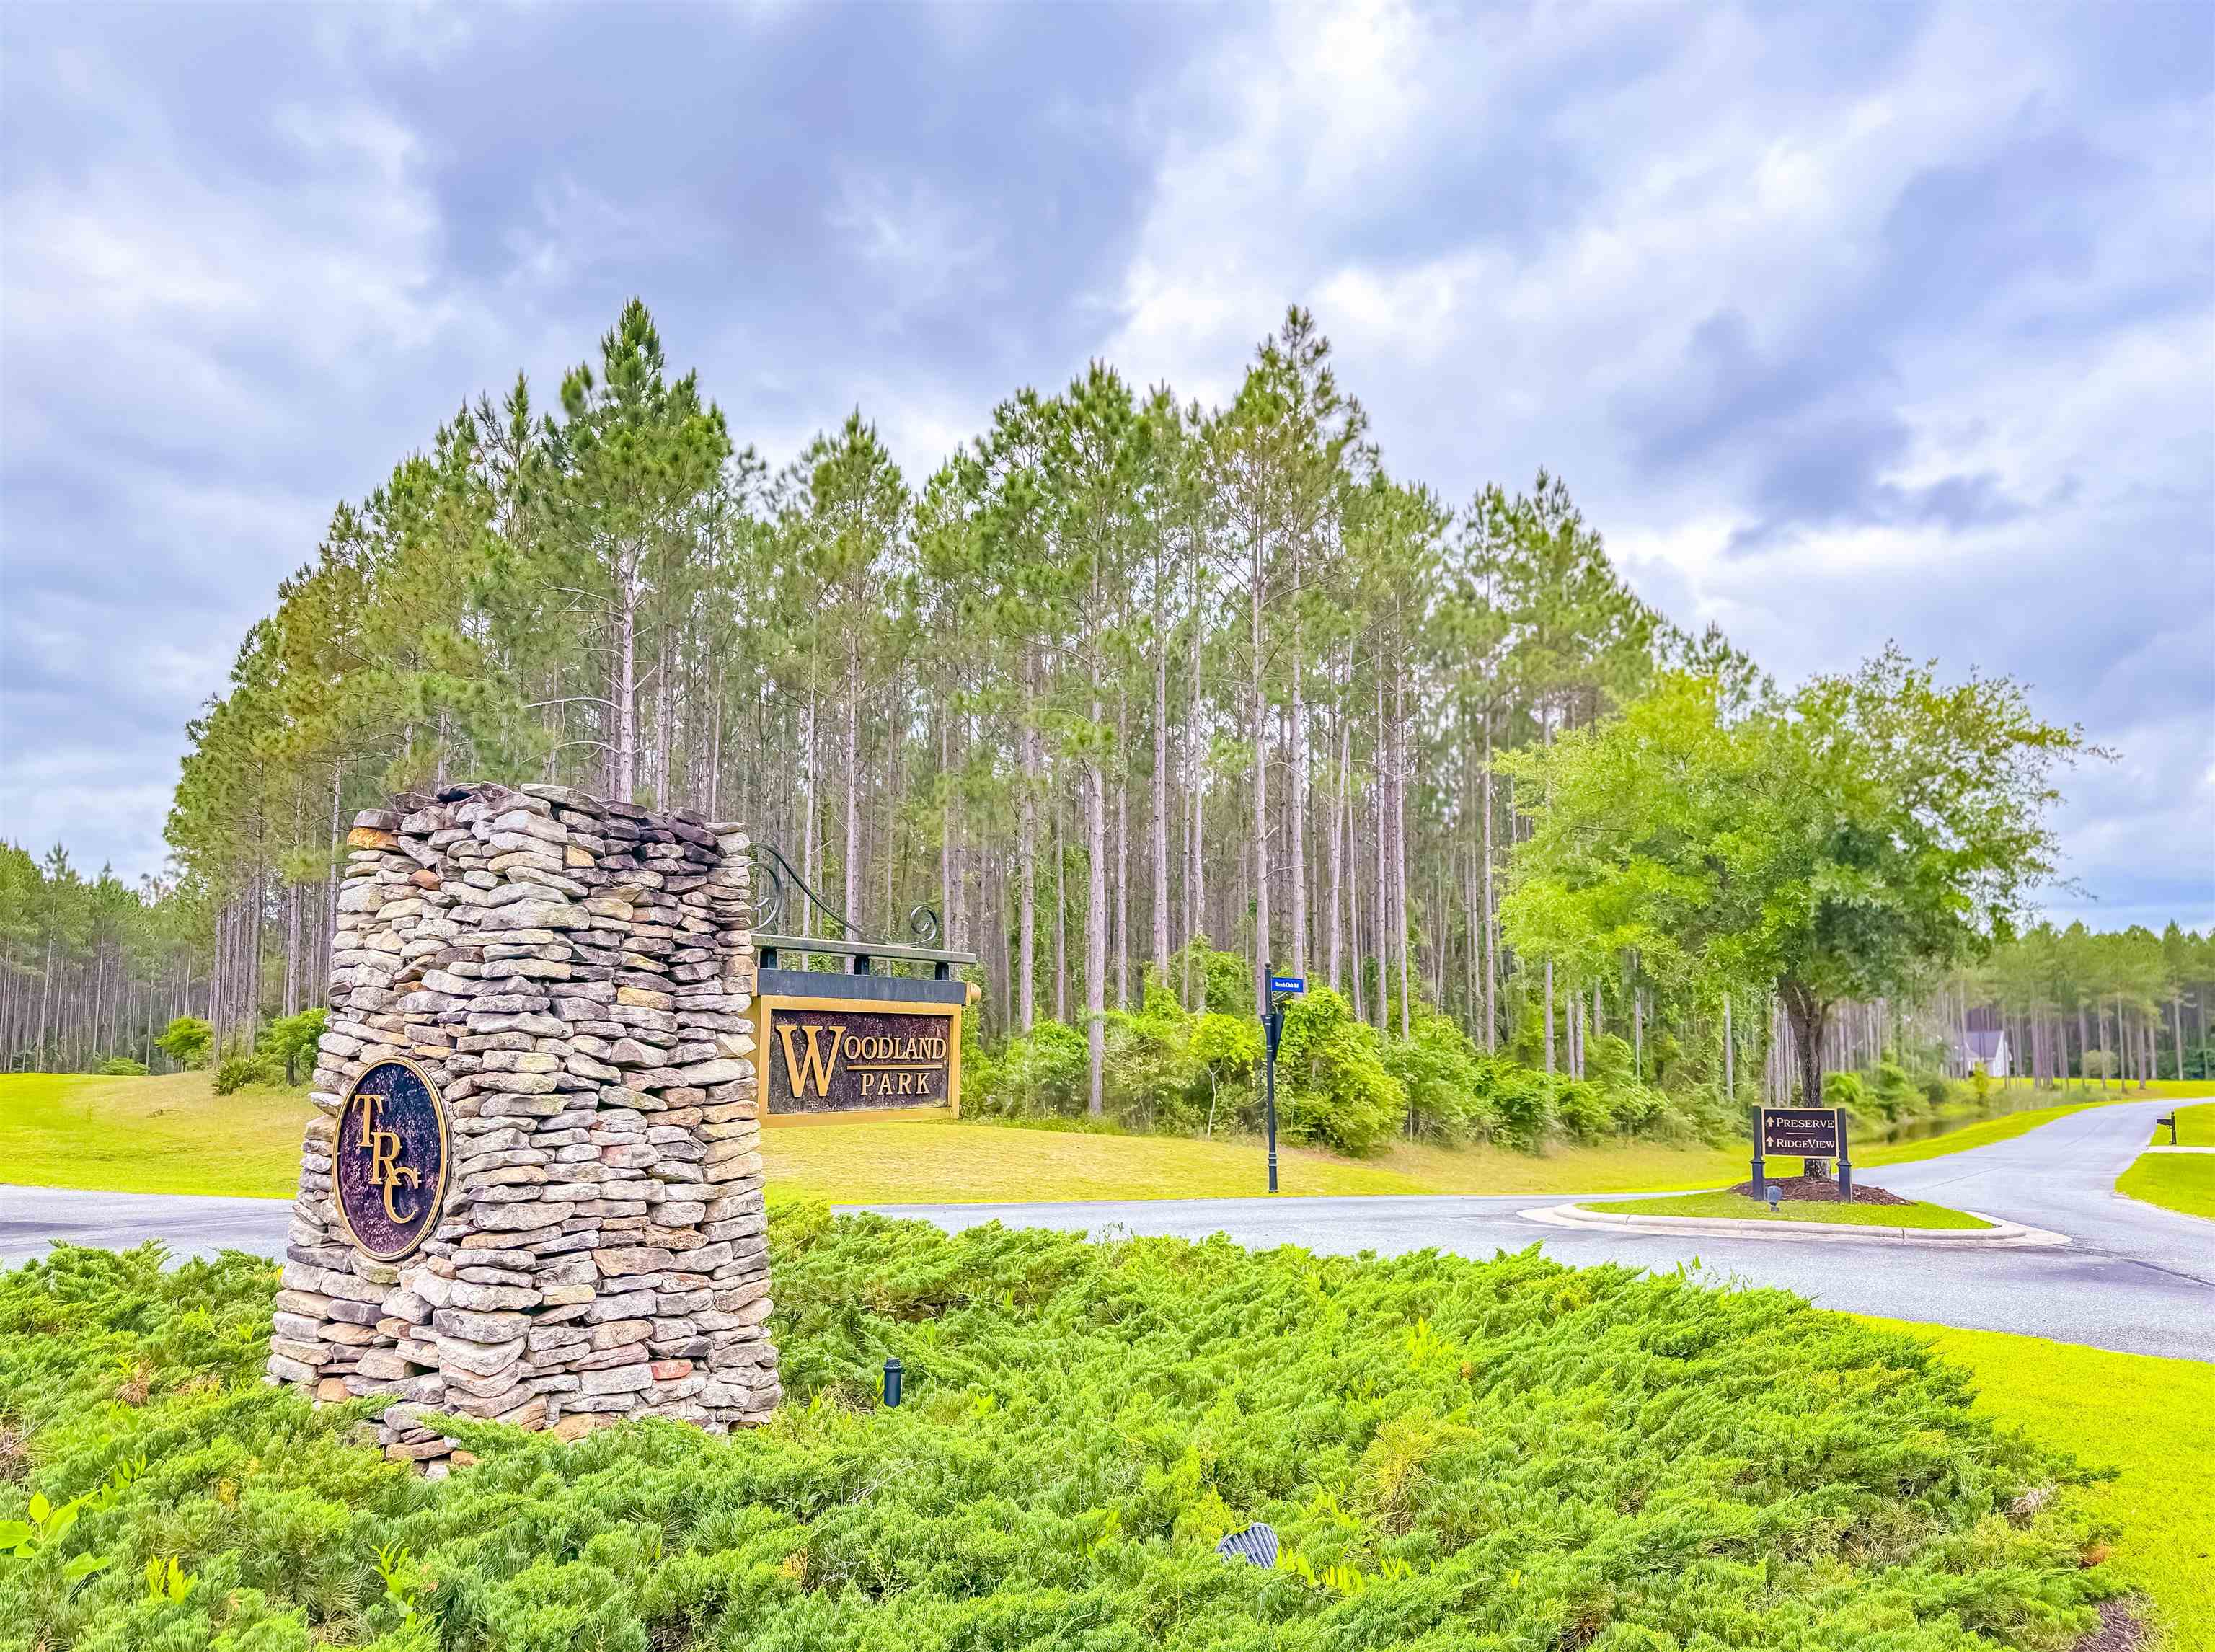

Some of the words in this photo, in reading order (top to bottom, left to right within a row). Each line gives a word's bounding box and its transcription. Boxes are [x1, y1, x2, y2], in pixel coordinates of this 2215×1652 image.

[775, 1025, 947, 1097] WOODLAND
[860, 1072, 931, 1096] PARK
[1776, 1117, 1835, 1128] PRESERVE
